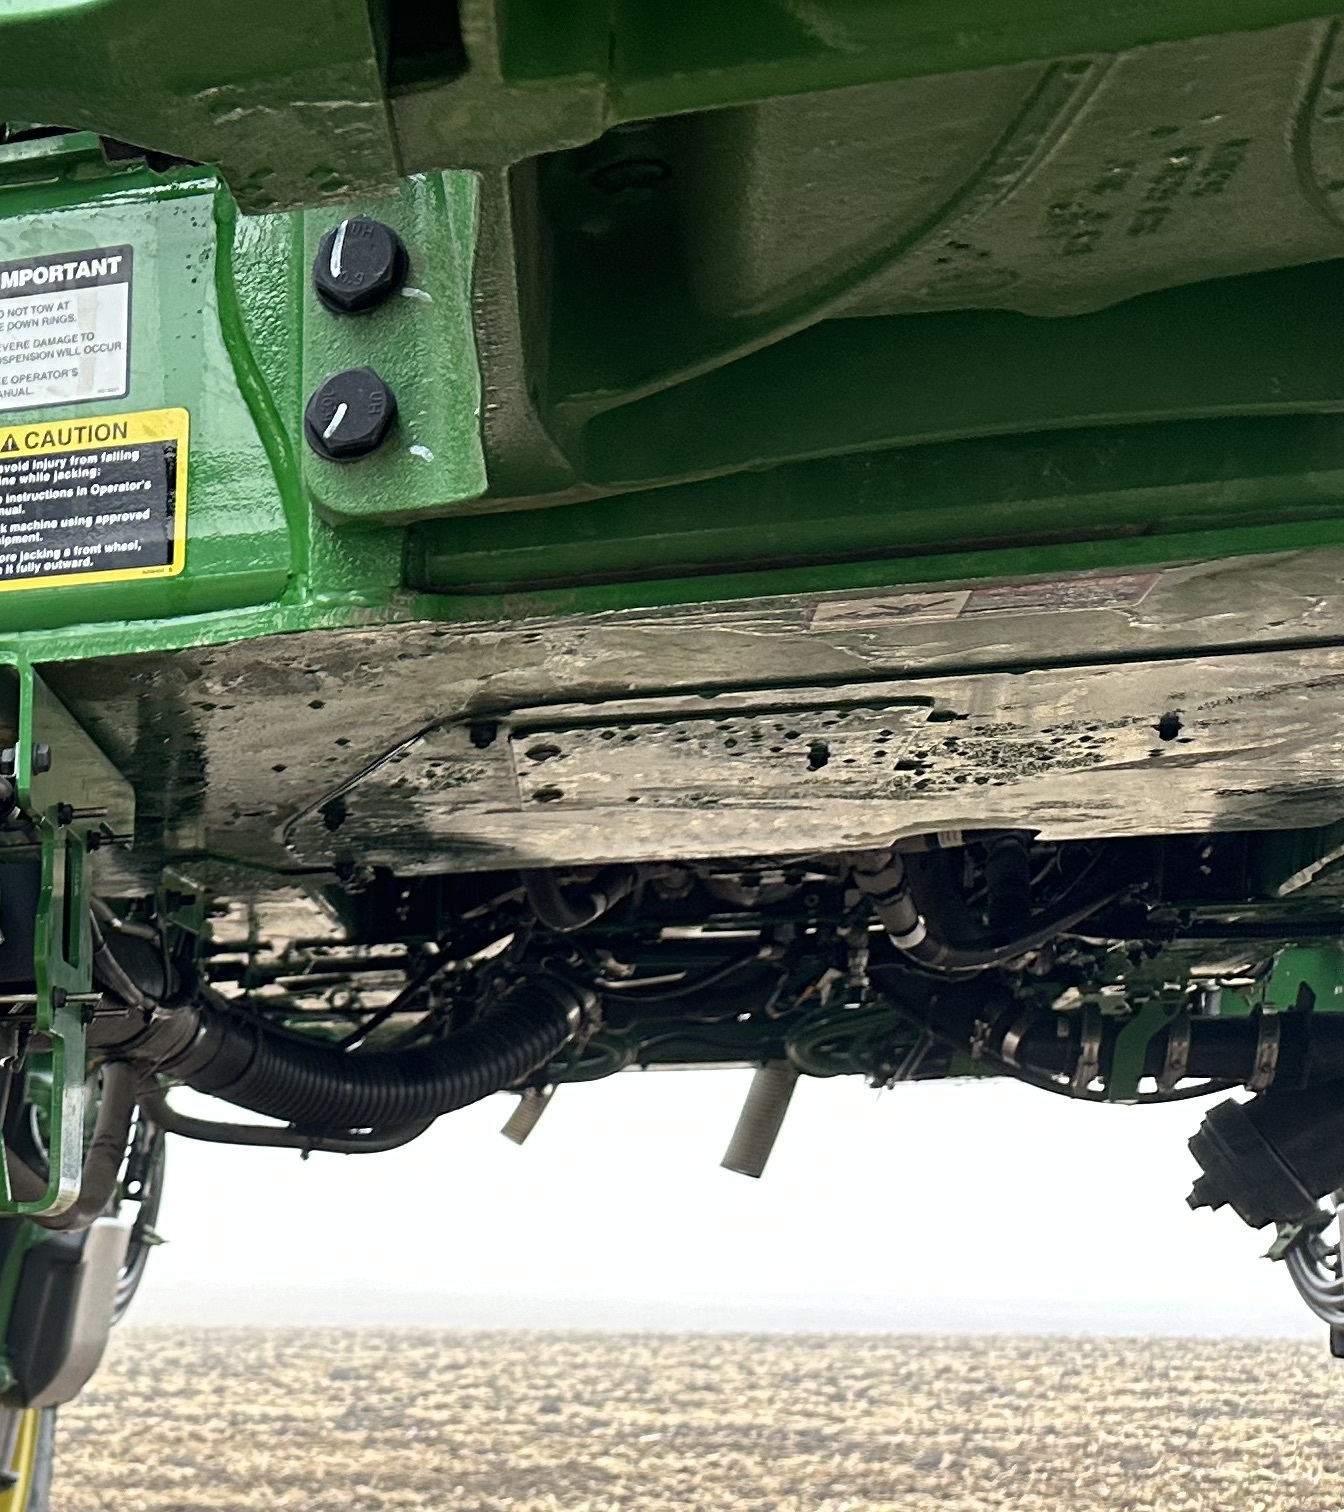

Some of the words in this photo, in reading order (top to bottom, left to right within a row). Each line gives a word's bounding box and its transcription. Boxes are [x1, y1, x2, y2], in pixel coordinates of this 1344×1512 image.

[7, 306, 28, 317] NOT
[31, 303, 53, 314] TOW
[57, 301, 70, 311] AT
[7, 318, 39, 332] DOWN
[42, 314, 77, 326] RINGS.
[33, 334, 78, 348] DAMAGE
[81, 332, 95, 342] TO
[57, 346, 81, 358] WILL
[84, 341, 121, 354] OCCUR
[11, 368, 78, 384] OPERATOR'S
[25, 421, 128, 449] CAUTION
[33, 456, 67, 471] injury
[70, 454, 98, 467] from
[101, 450, 140, 464] falling
[19, 472, 50, 484] while
[53, 467, 101, 483] jacking:
[5, 488, 74, 503] instructions
[77, 486, 88, 496] in
[90, 479, 152, 497] Operator's
[9, 518, 58, 532] machine
[60, 515, 93, 529] using
[95, 508, 151, 525] approved
[19, 548, 61, 564] jacking
[73, 543, 102, 556] front
[104, 540, 142, 553] wheel,
[5, 563, 14, 574] it
[16, 559, 41, 575] fully
[44, 557, 94, 571] outward.
